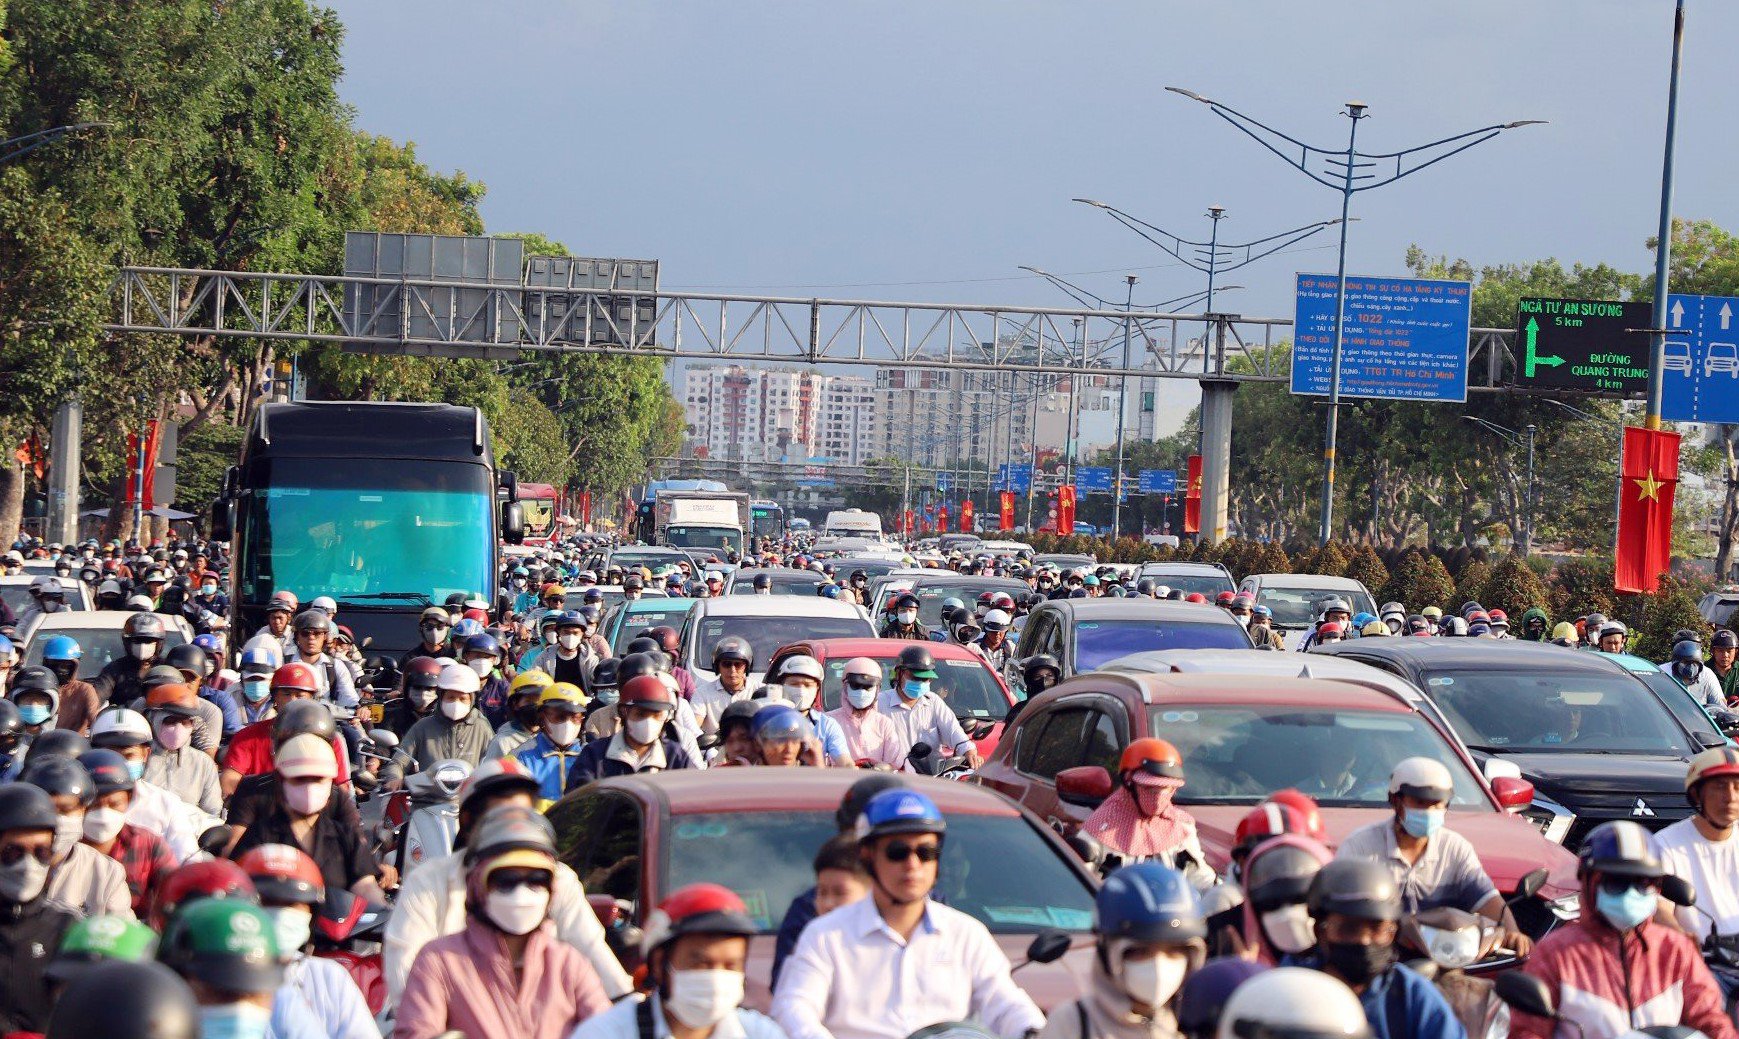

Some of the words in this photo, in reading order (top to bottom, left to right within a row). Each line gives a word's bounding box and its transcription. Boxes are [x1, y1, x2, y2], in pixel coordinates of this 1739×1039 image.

[1520, 299, 1543, 313] NGÃ
[1545, 301, 1562, 314] TƯ
[1563, 302, 1579, 315] AN
[1581, 303, 1623, 317] SƯƠNG
[1358, 313, 1383, 324] 1022
[1555, 316, 1562, 326] 5
[1564, 317, 1583, 327] km
[1590, 352, 1631, 365] ĐƯỜNG
[1571, 365, 1610, 377] QUANG
[1612, 367, 1649, 379] TRUNG
[1595, 378, 1602, 388] 4
[1604, 379, 1623, 389] km
